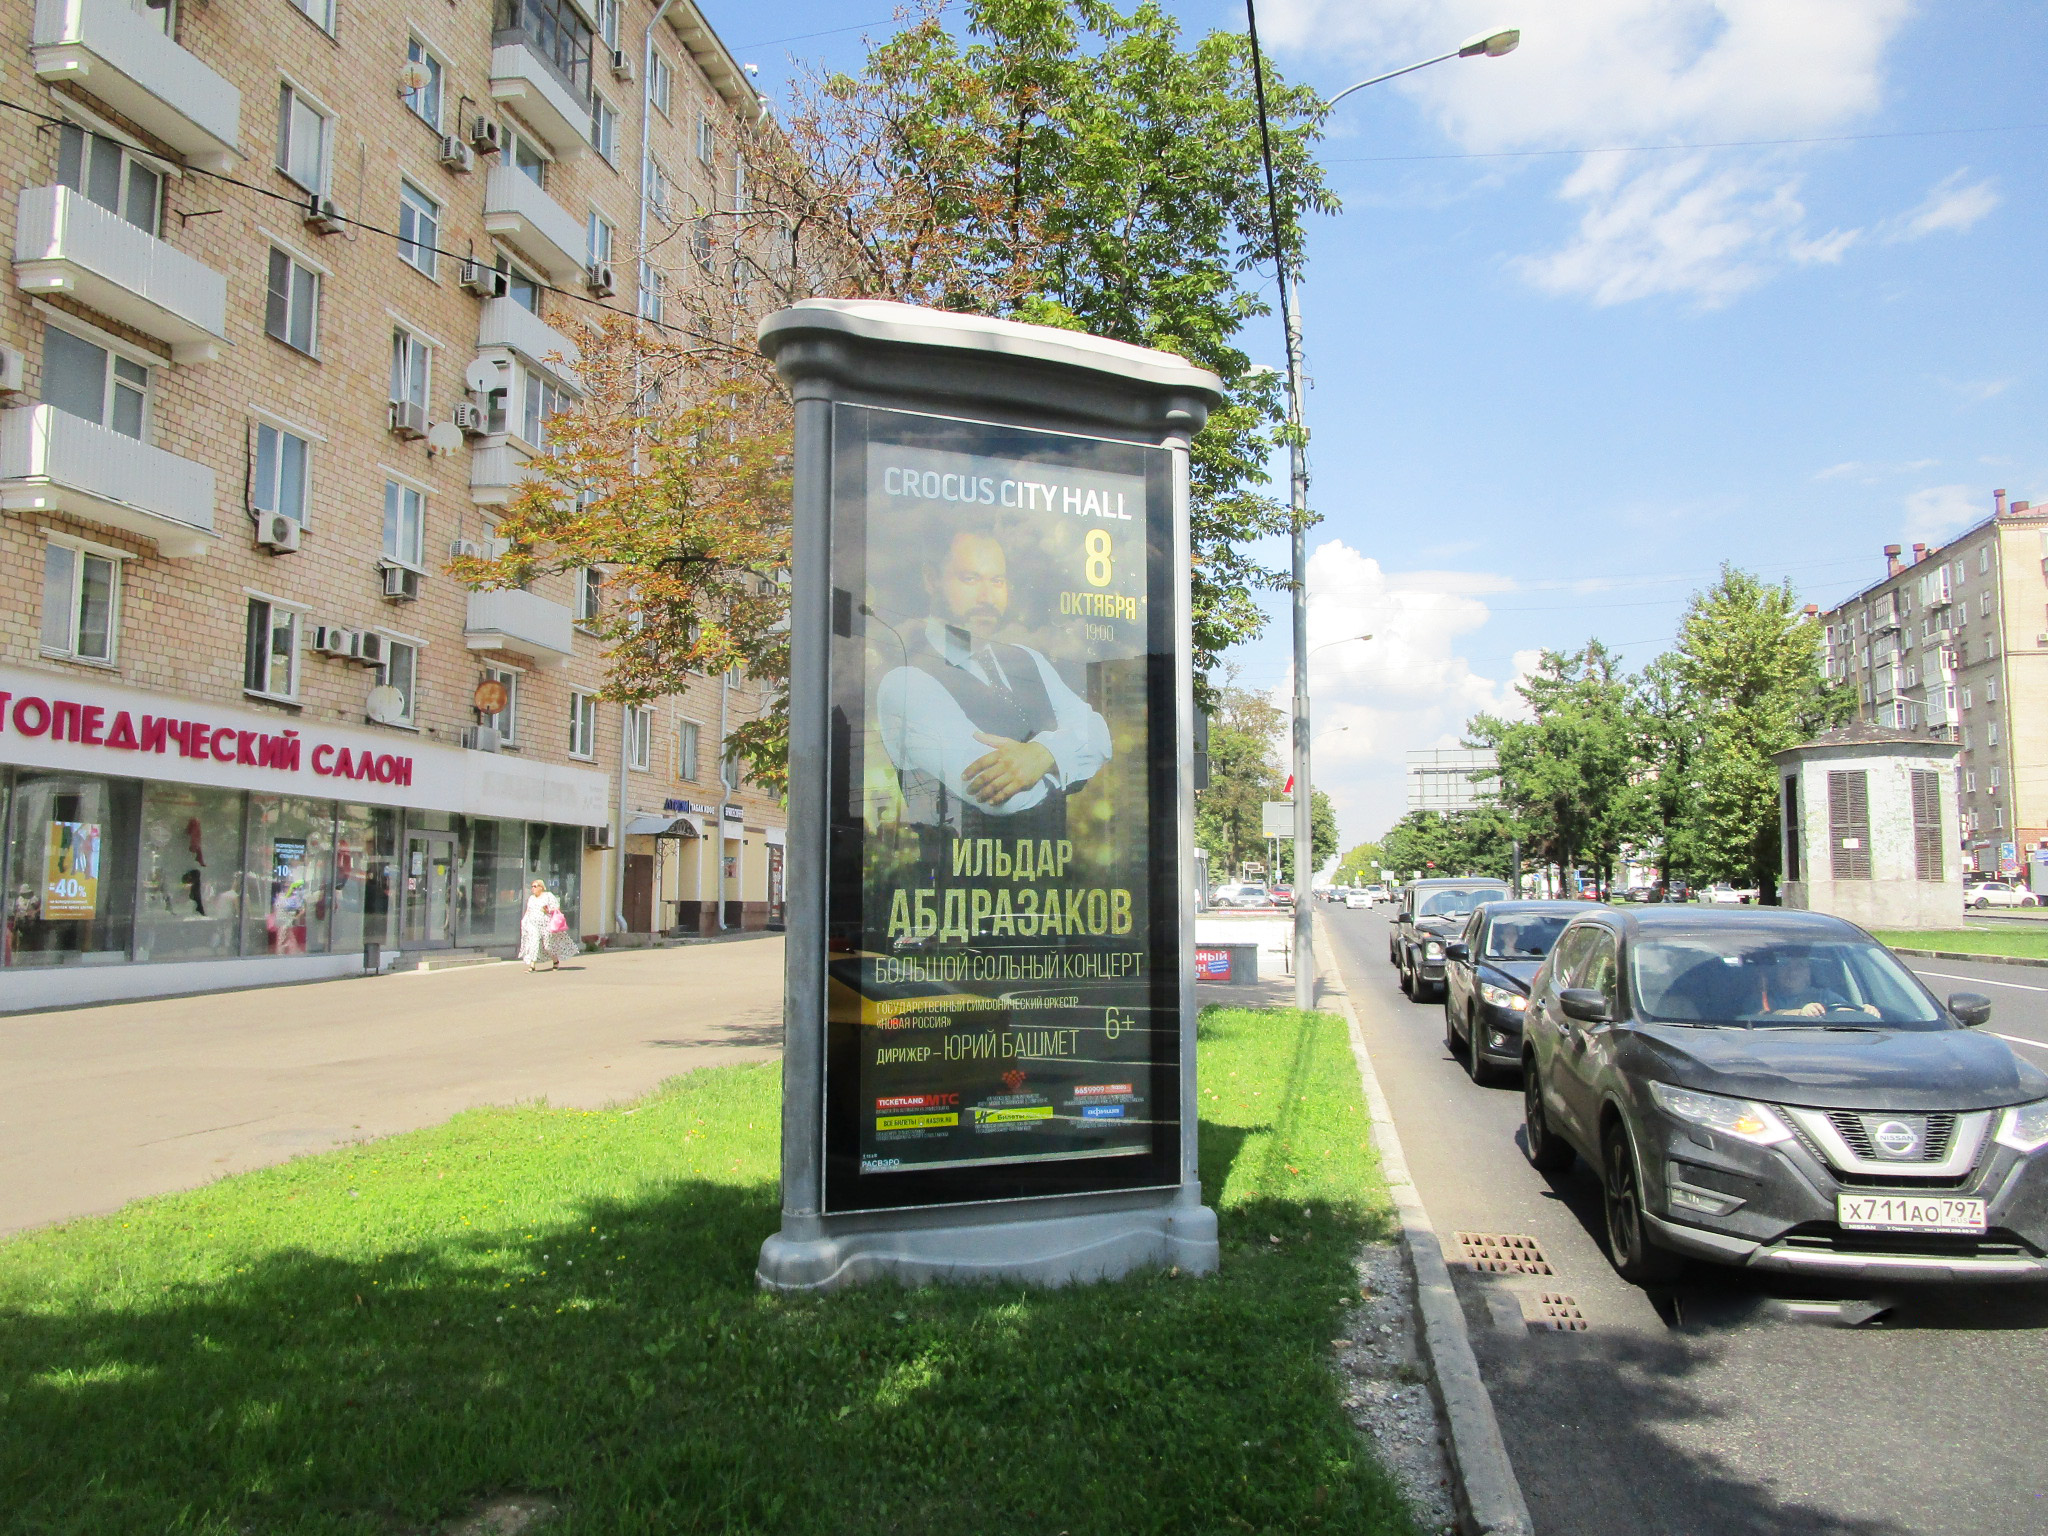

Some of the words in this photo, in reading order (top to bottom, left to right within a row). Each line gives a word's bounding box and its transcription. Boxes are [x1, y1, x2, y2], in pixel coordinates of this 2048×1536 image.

[885, 467, 995, 505] CROCUS
[1000, 480, 1058, 512] CITY
[1063, 487, 1132, 520] HALL
[1085, 529, 1112, 587] 8
[1060, 591, 1136, 620] ОКТЯБРЯ
[1085, 623, 1114, 642] 19:00
[312, 744, 413, 786] САЛОН
[952, 838, 1073, 882] ИЛЬДАР
[887, 888, 1133, 944] АБДРАЗАКОВ
[875, 952, 968, 983] БОЛЬШОЙ
[973, 951, 1059, 981] СОЛЬНЫЙ
[1063, 952, 1144, 980] КОНЦЕРТ
[876, 998, 965, 1015] ГОСУДАРСТВЕННЫЙ
[966, 996, 1042, 1013] СИМФОНИЧЕСКИЙ
[1044, 996, 1079, 1009] ОРКЕСТР
[912, 1016, 952, 1029] РОССИЯ»
[1105, 1006, 1135, 1040] 6+
[876, 1047, 931, 1065] ДИРИЖЕР
[944, 1029, 996, 1061] ЮРИЙ
[1002, 1029, 1080, 1058] БАШМЕТ
[879, 1097, 924, 1106] TICKETLAND
[1879, 1134, 1914, 1142] NISSAN
